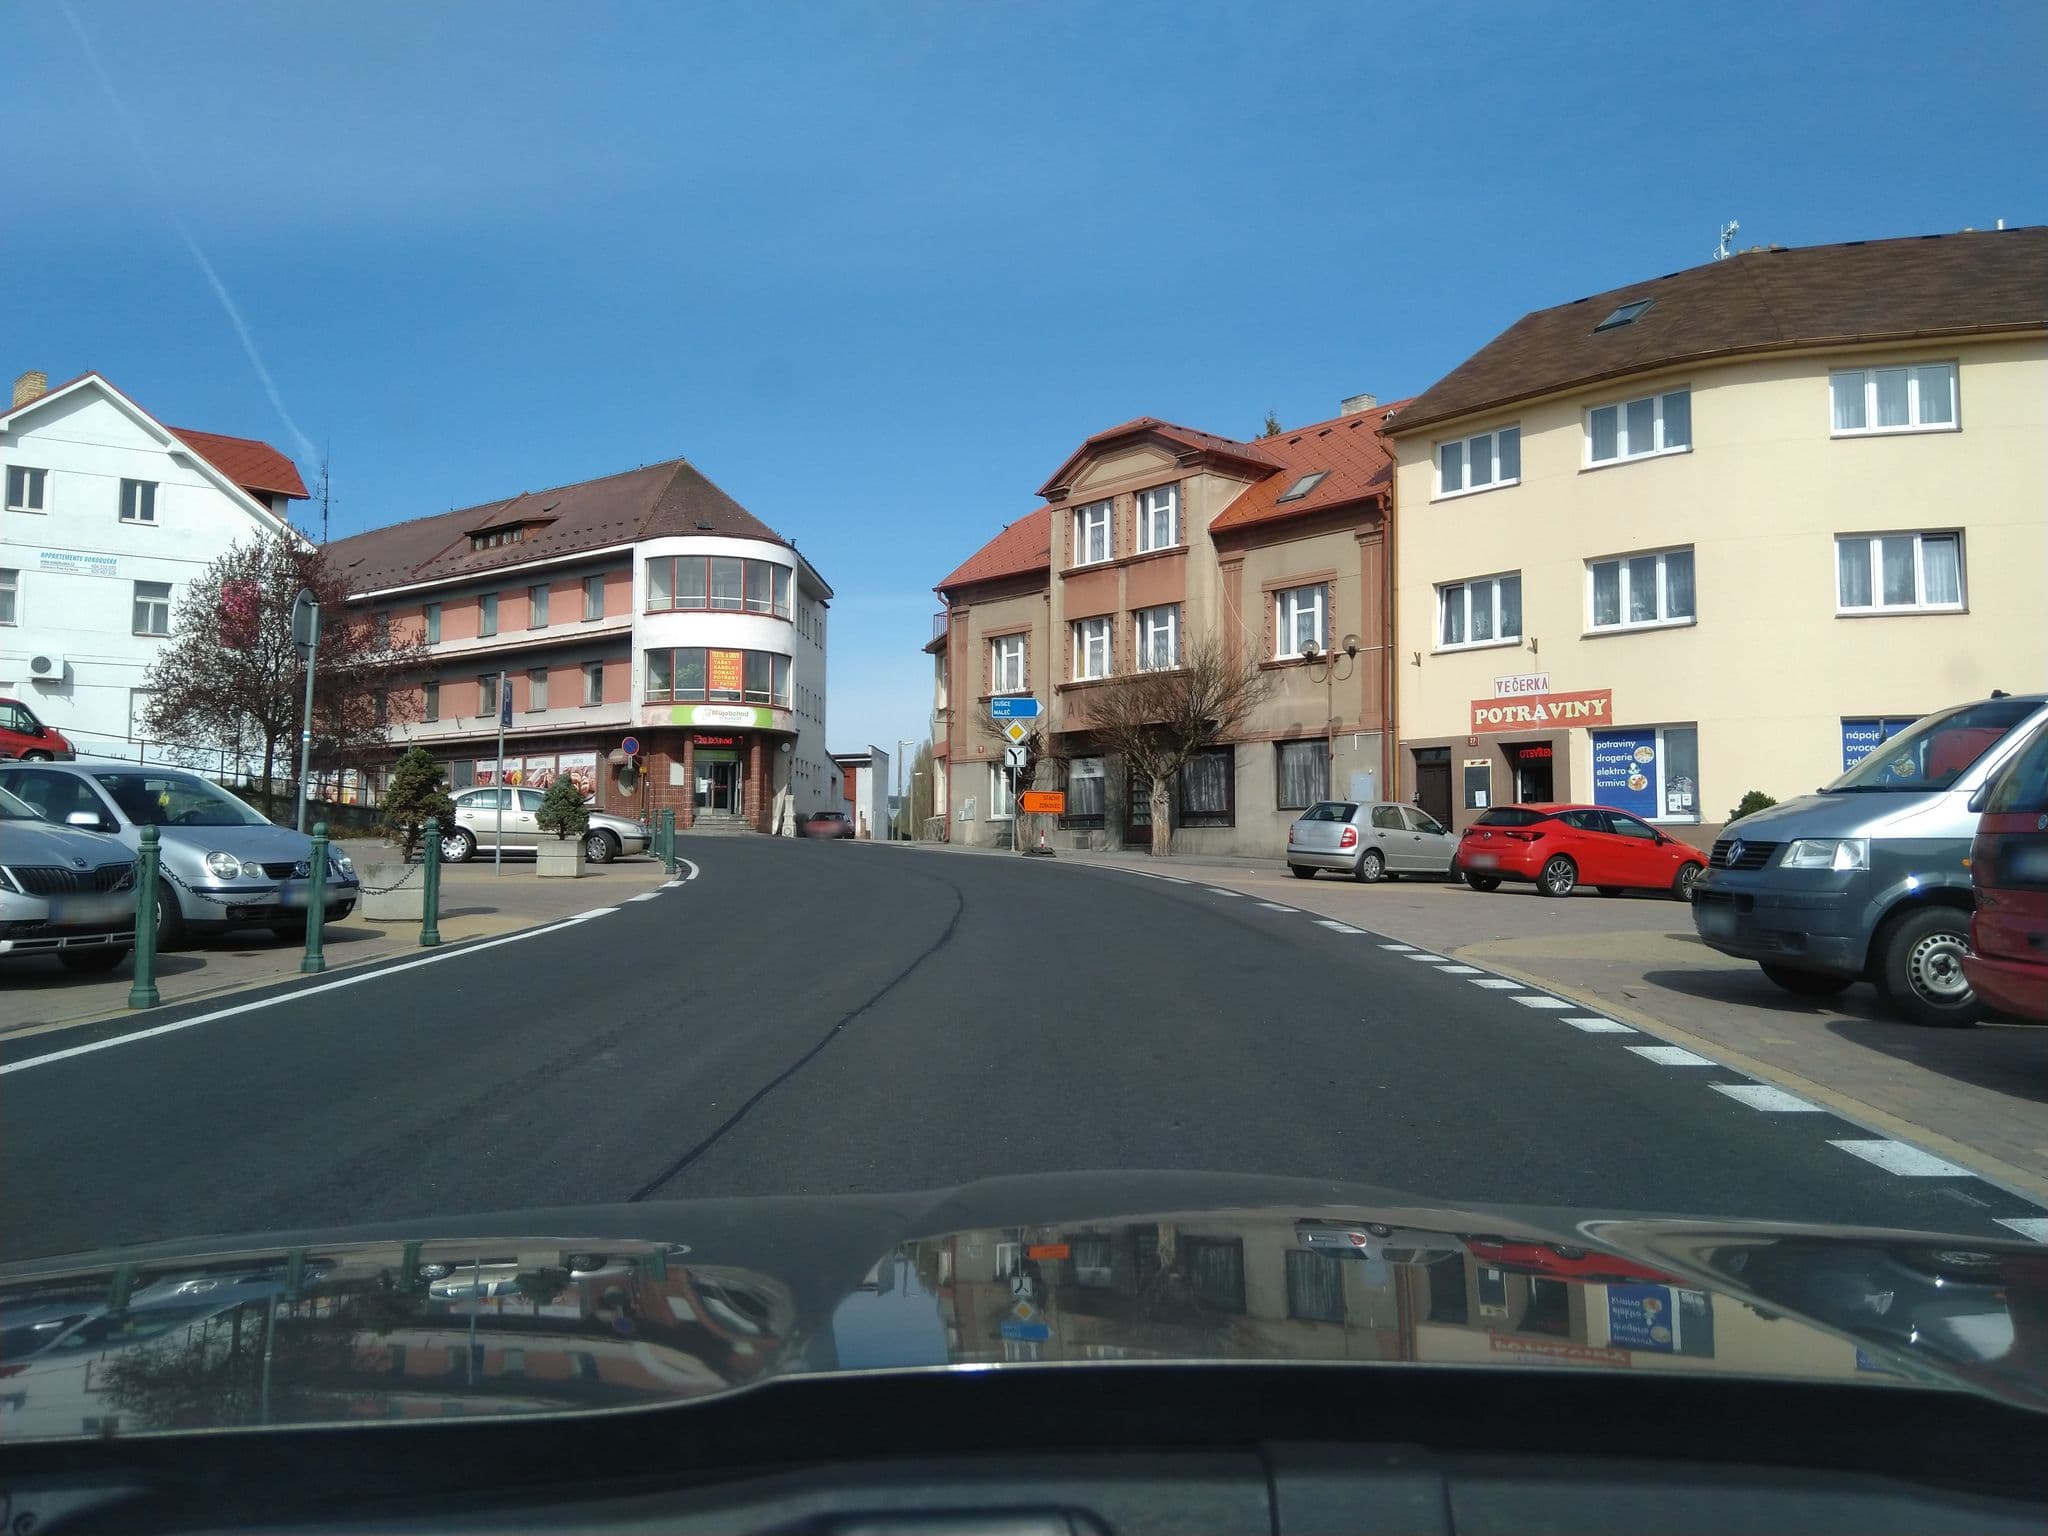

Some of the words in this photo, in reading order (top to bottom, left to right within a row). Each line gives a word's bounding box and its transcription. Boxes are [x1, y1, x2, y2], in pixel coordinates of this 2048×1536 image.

[1496, 677, 1548, 693] VEČERKA
[1475, 698, 1608, 725] POTRAVINY
[1596, 739, 1637, 750] potraviny
[1596, 753, 1633, 765] drogerie
[1596, 767, 1626, 776] elektro
[1596, 778, 1626, 787] krmiva
